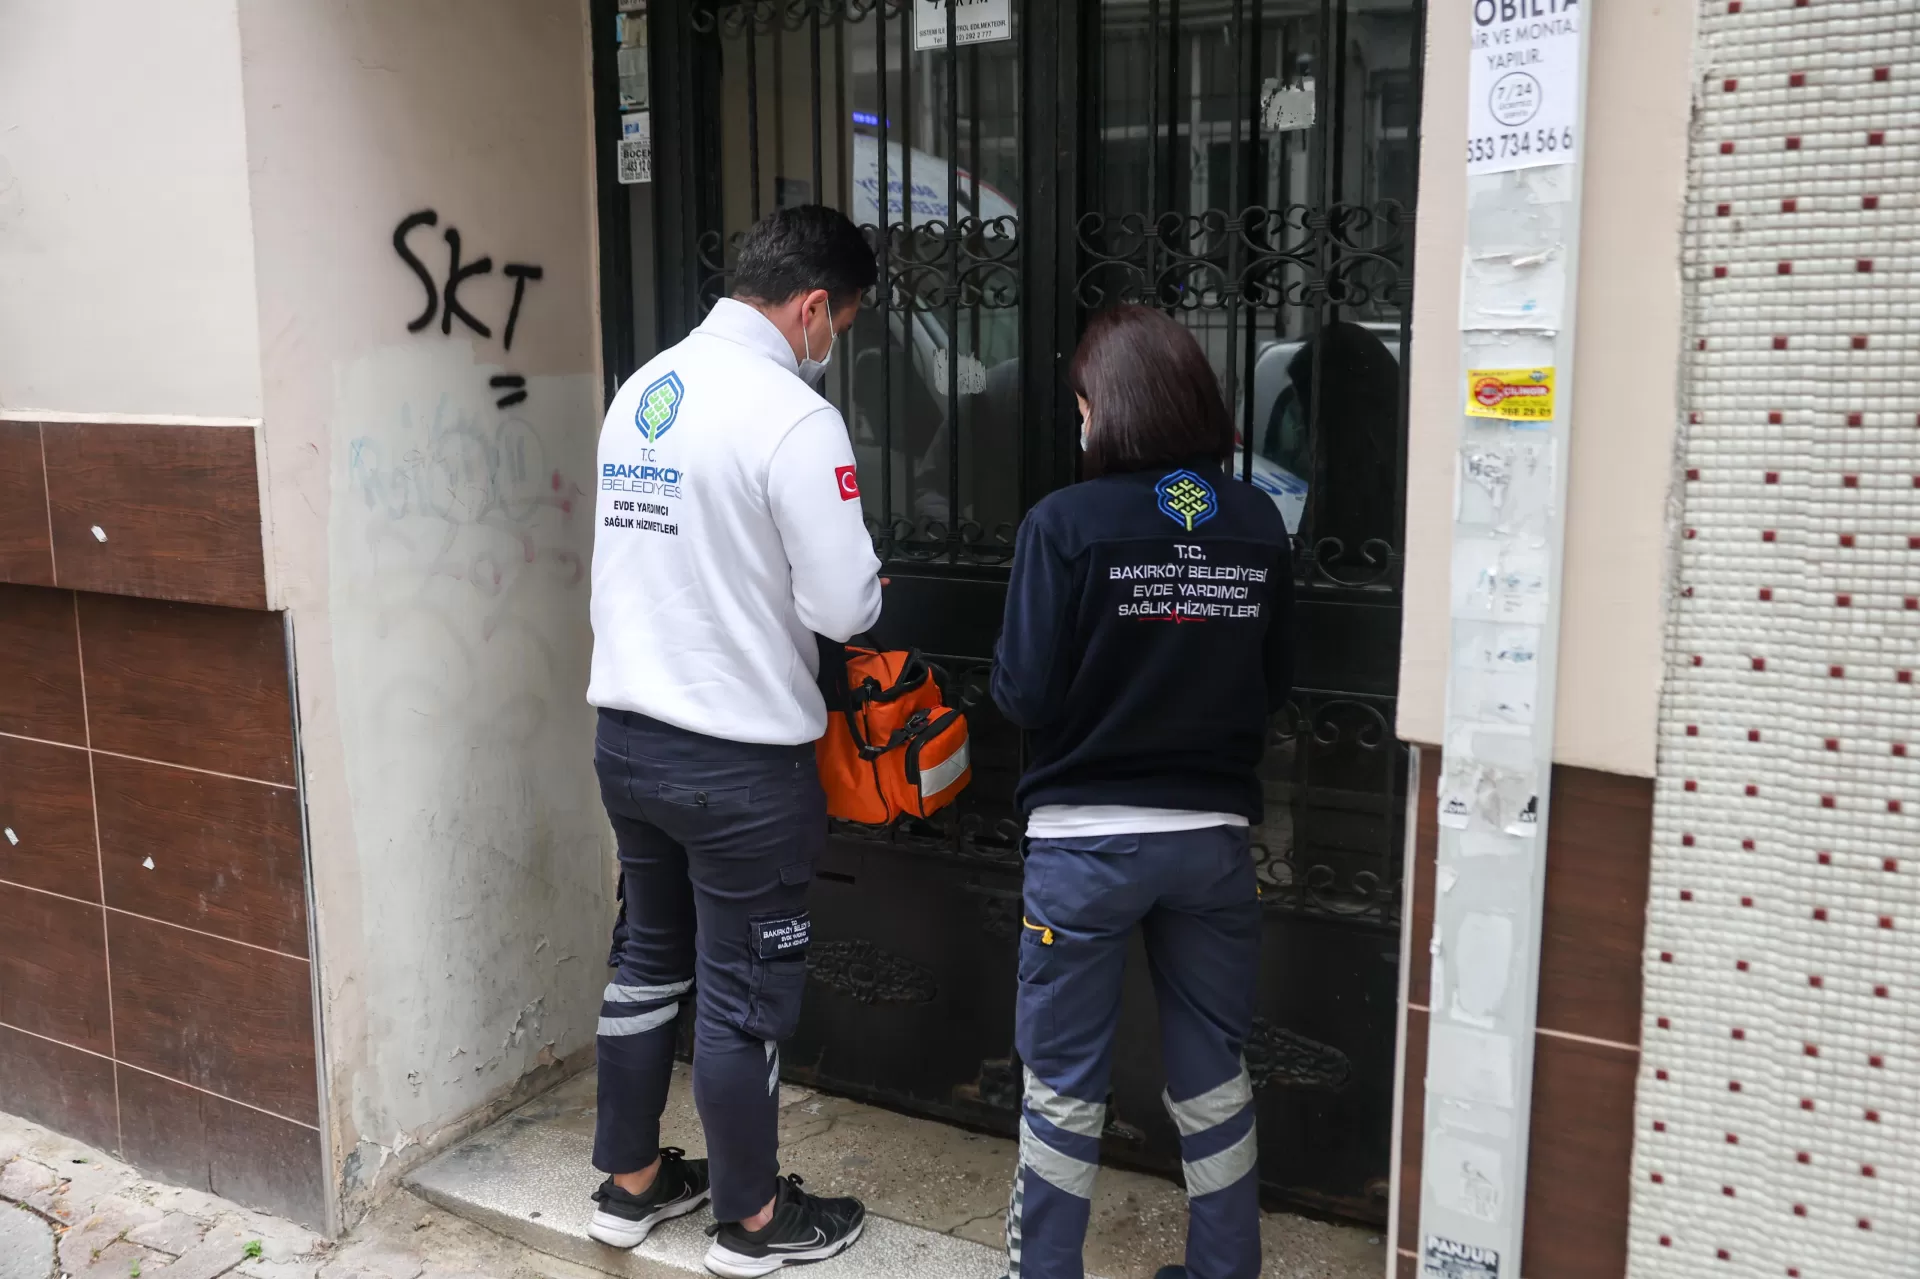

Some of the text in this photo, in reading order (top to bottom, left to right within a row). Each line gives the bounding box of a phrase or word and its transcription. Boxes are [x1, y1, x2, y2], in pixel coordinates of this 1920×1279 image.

[1492, 28, 1511, 44] VE
[1500, 131, 1530, 158] 734
[1536, 127, 1557, 152] 56
[392, 209, 543, 352] SKT
[640, 448, 657, 462] T.C.
[602, 463, 683, 485] BAKIRKÖY
[613, 500, 669, 516] EVDE YARDIMCI
[604, 516, 679, 536] SAĞLIK HİZMETLERİ
[1173, 544, 1206, 560] T.C.
[1109, 563, 1268, 583] BAKIRKÖY BELEDİYESİ
[1133, 583, 1249, 599] EVDE YARDIMCI
[1118, 600, 1261, 618] SAĞLIK HİZMETLERİ
[1426, 1235, 1498, 1267] PANJUR
